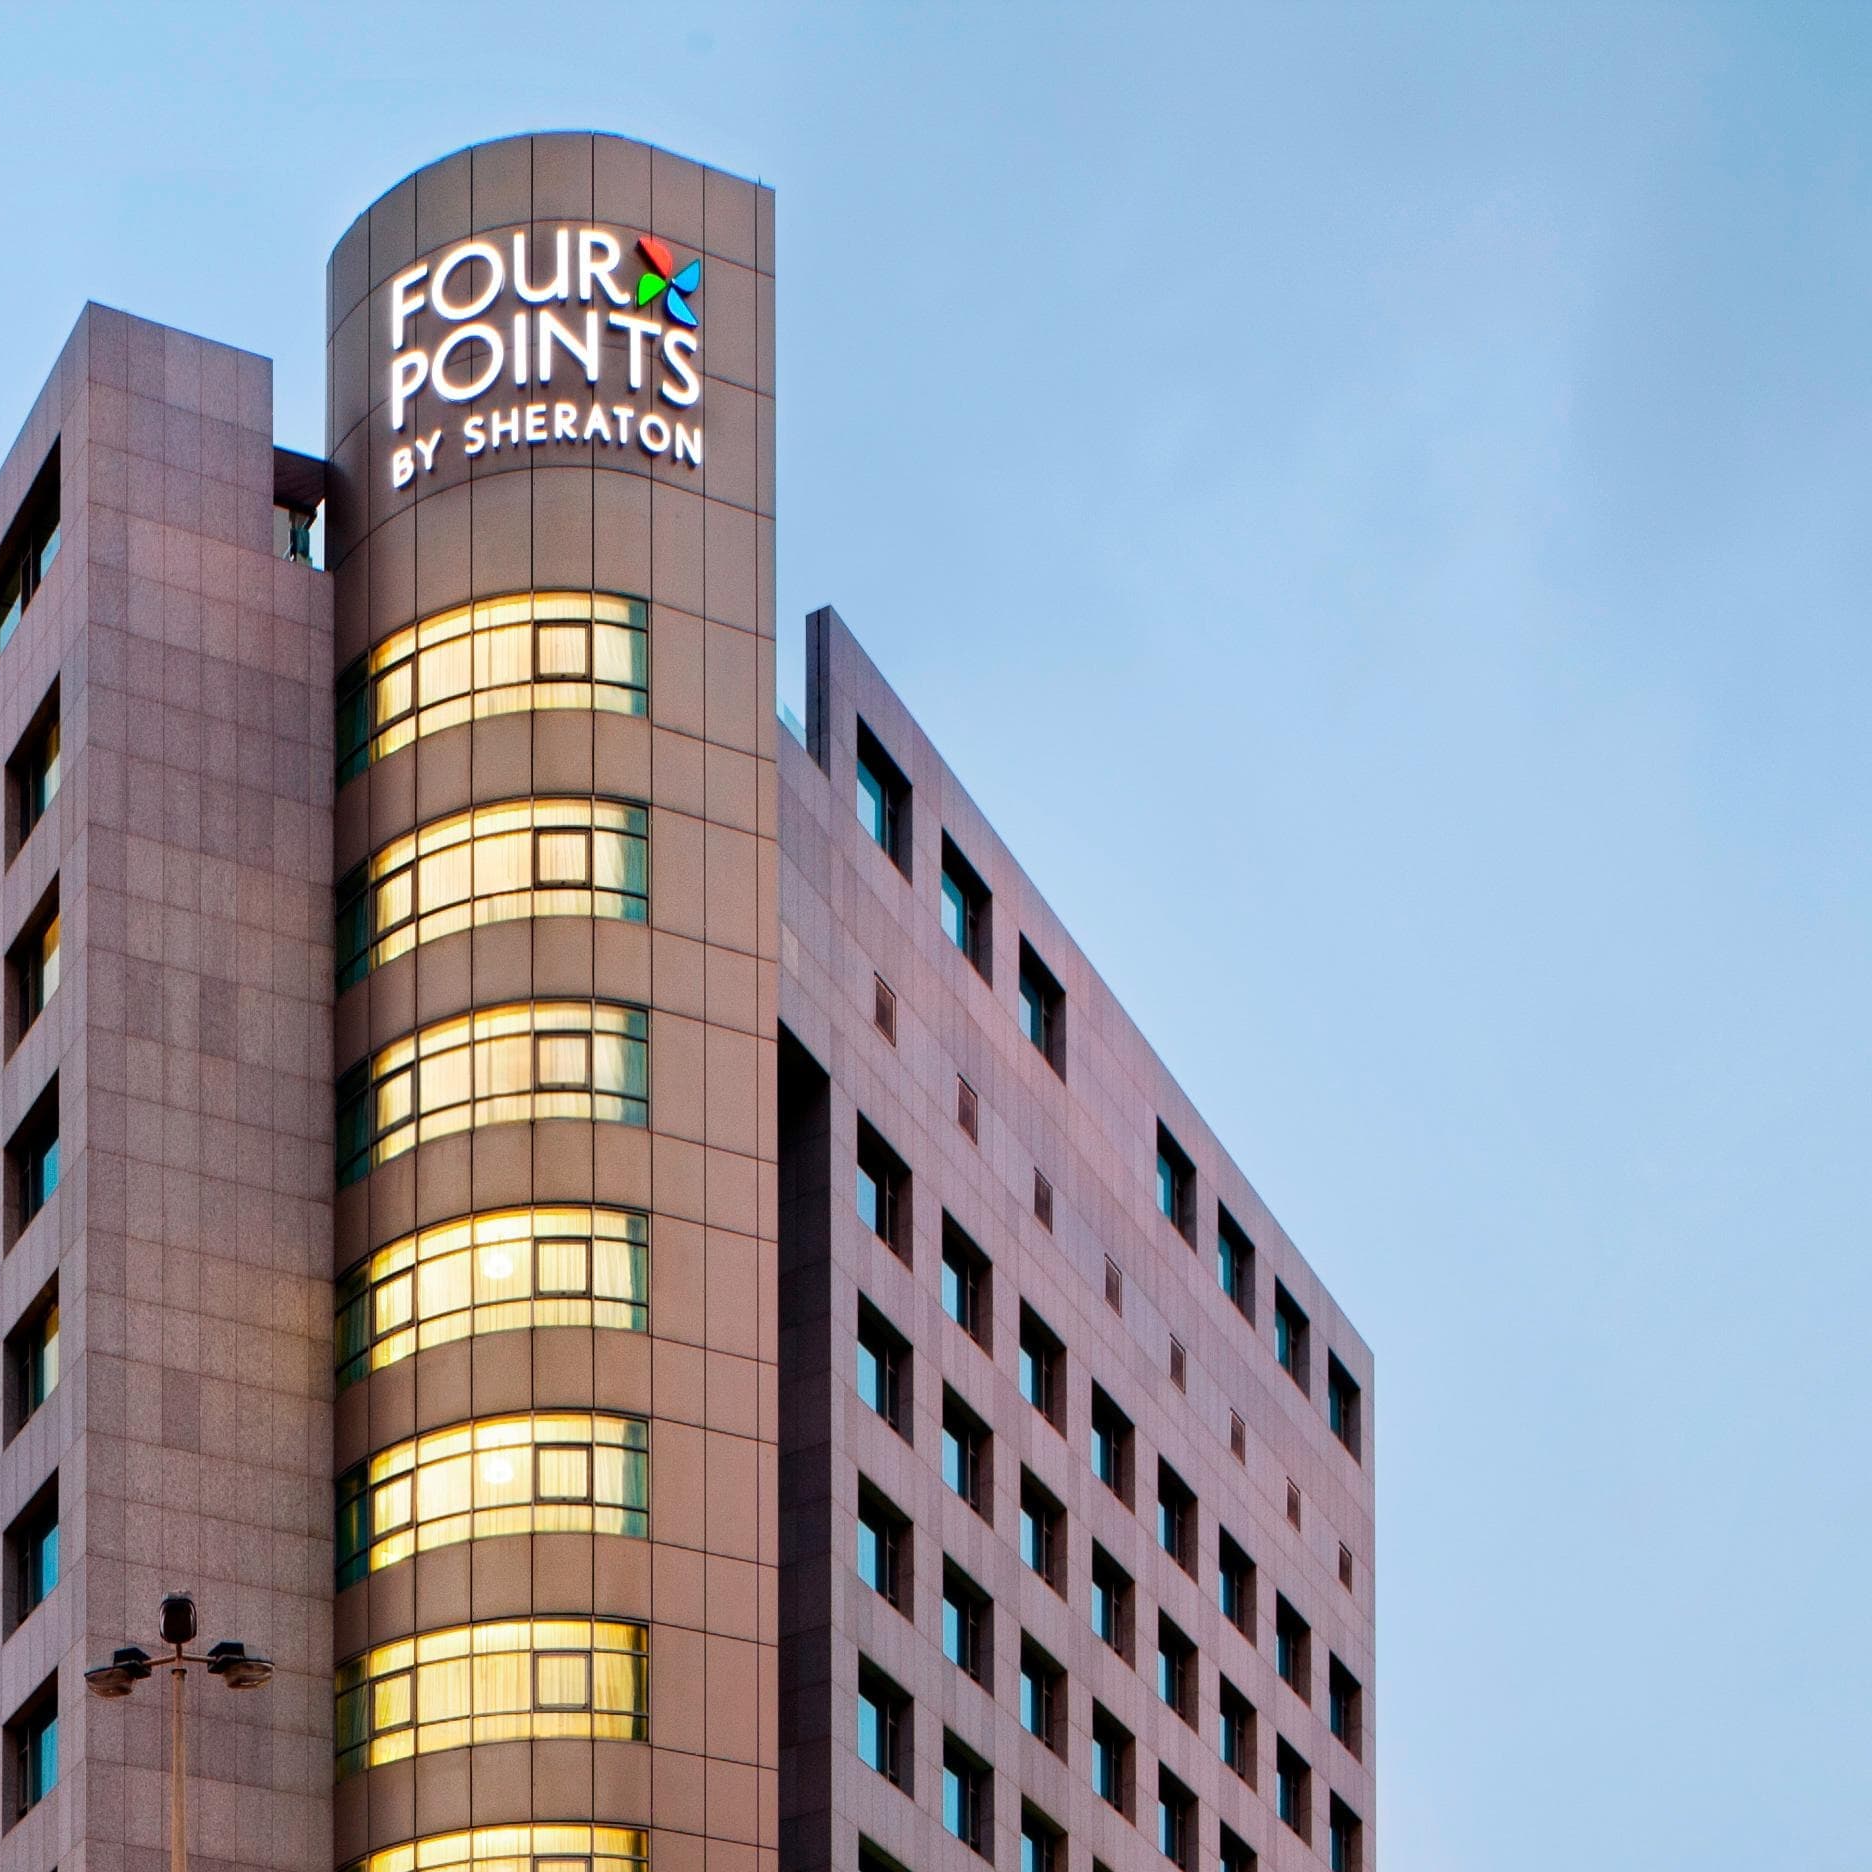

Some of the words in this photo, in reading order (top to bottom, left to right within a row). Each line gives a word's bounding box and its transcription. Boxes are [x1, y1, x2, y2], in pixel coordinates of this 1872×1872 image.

[391, 228, 633, 350] FOUR
[391, 310, 702, 431] POINTS
[392, 429, 443, 489] BY
[463, 402, 703, 466] SHERATON
